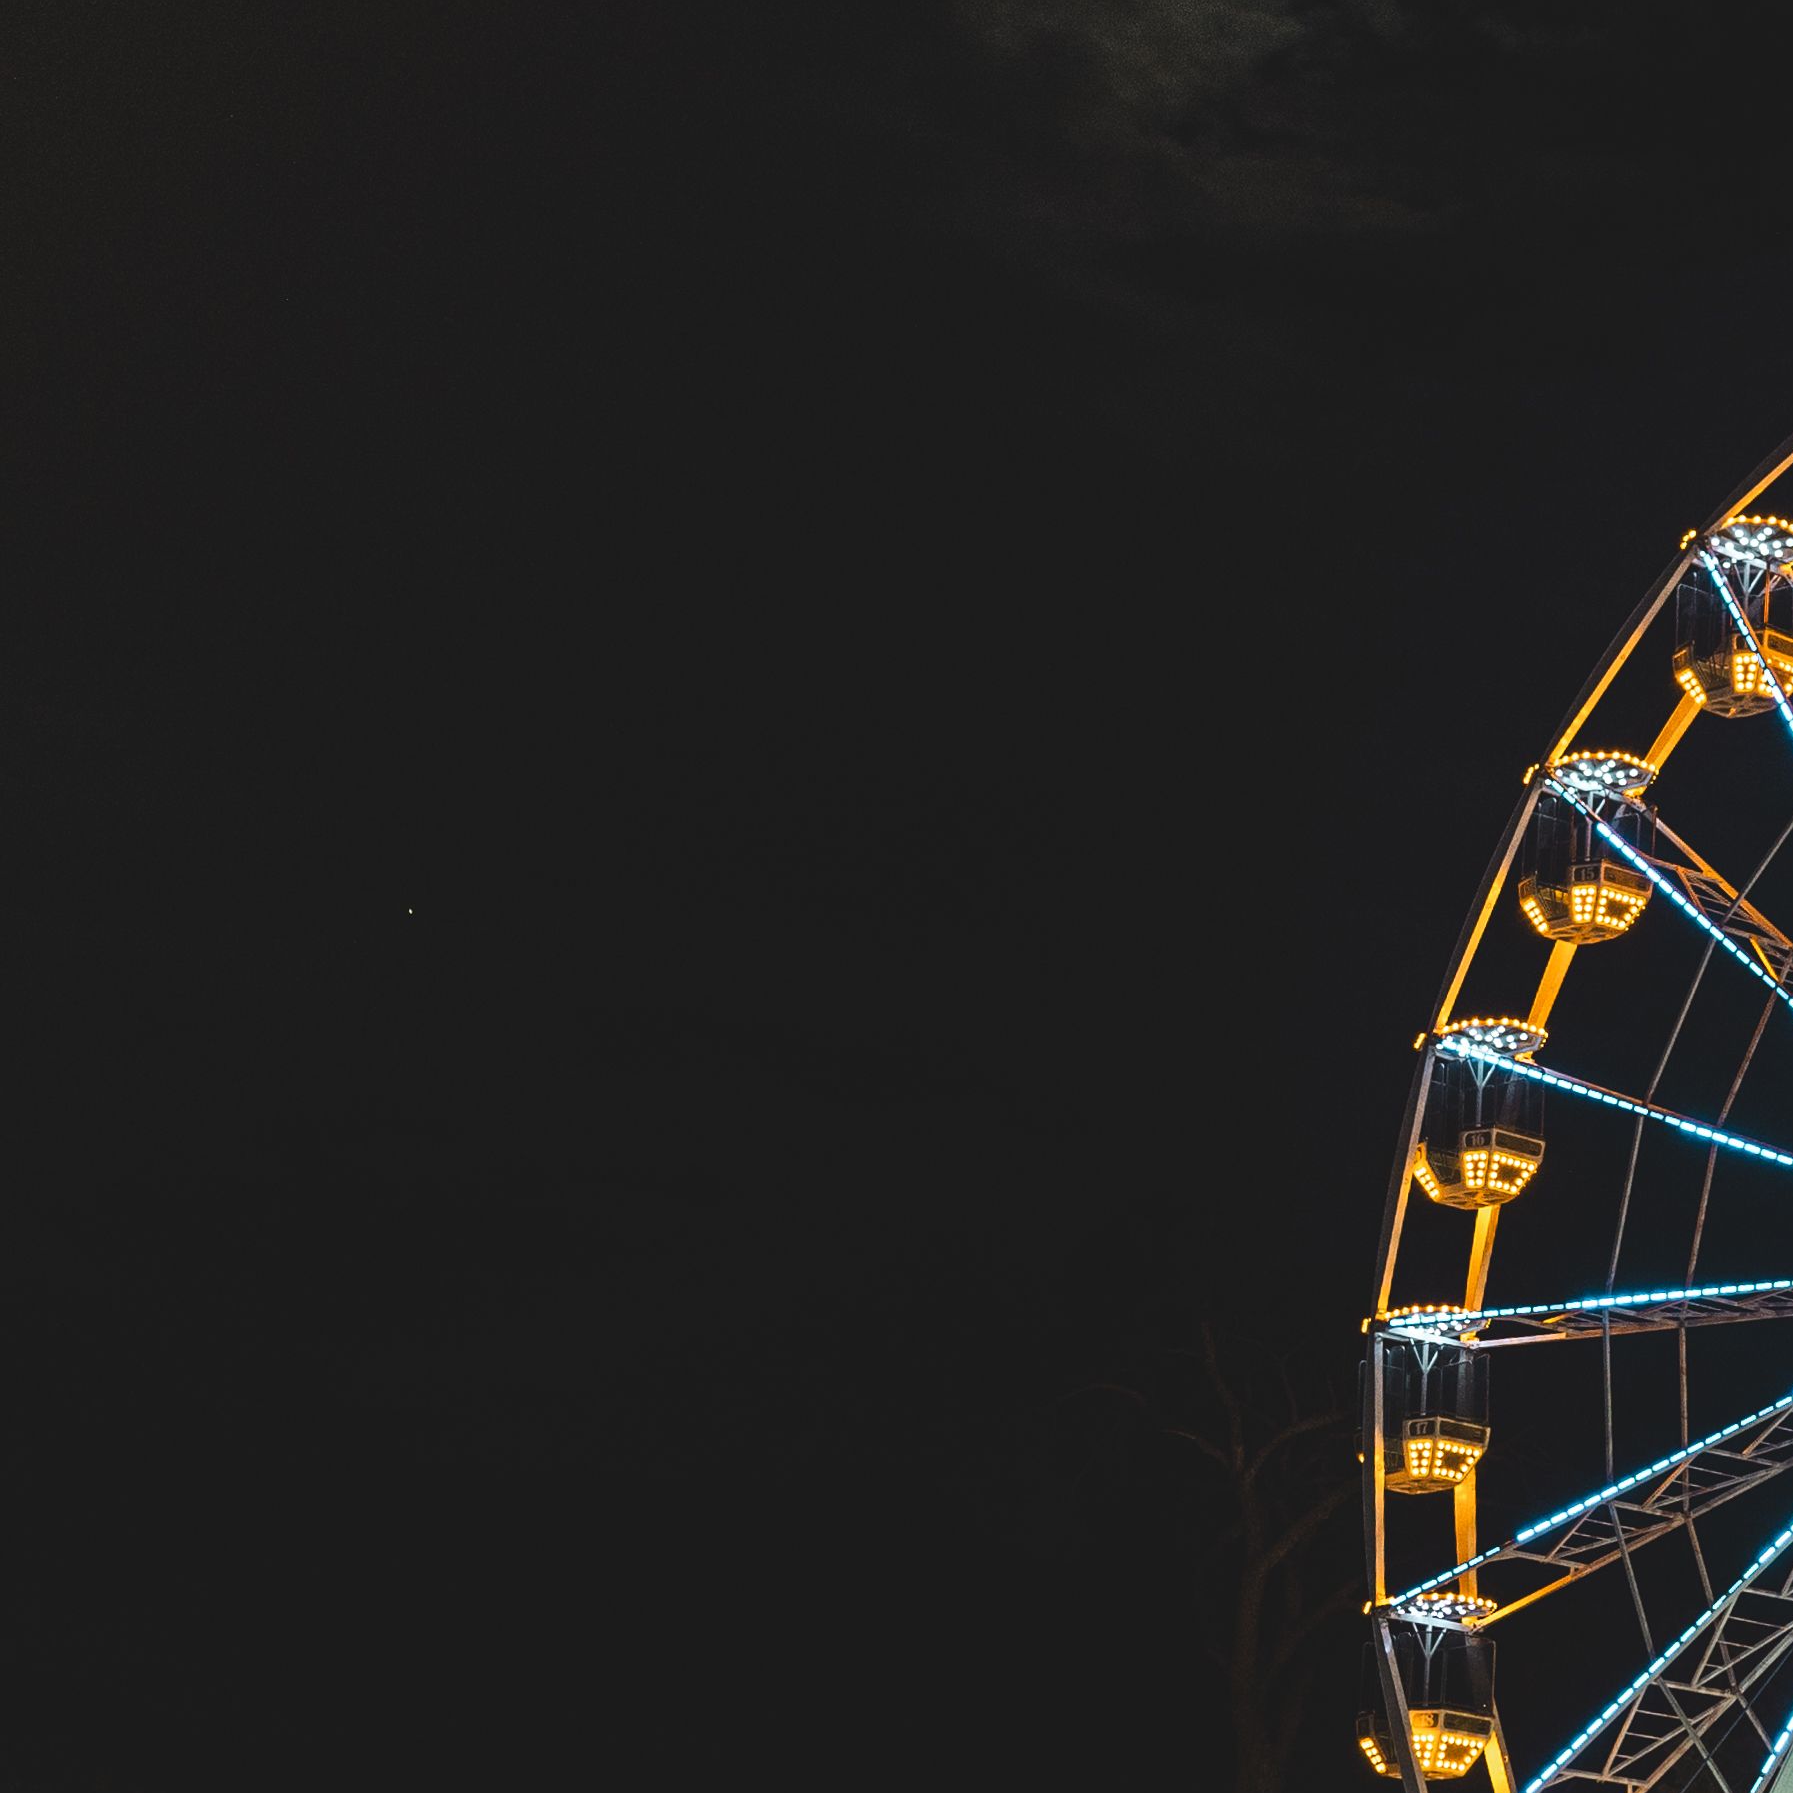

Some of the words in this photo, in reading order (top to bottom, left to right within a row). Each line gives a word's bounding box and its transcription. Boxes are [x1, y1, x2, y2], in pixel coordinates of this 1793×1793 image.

[1580, 867, 1595, 878] 15
[1471, 1133, 1485, 1145] 16
[1415, 1422, 1428, 1435] 17
